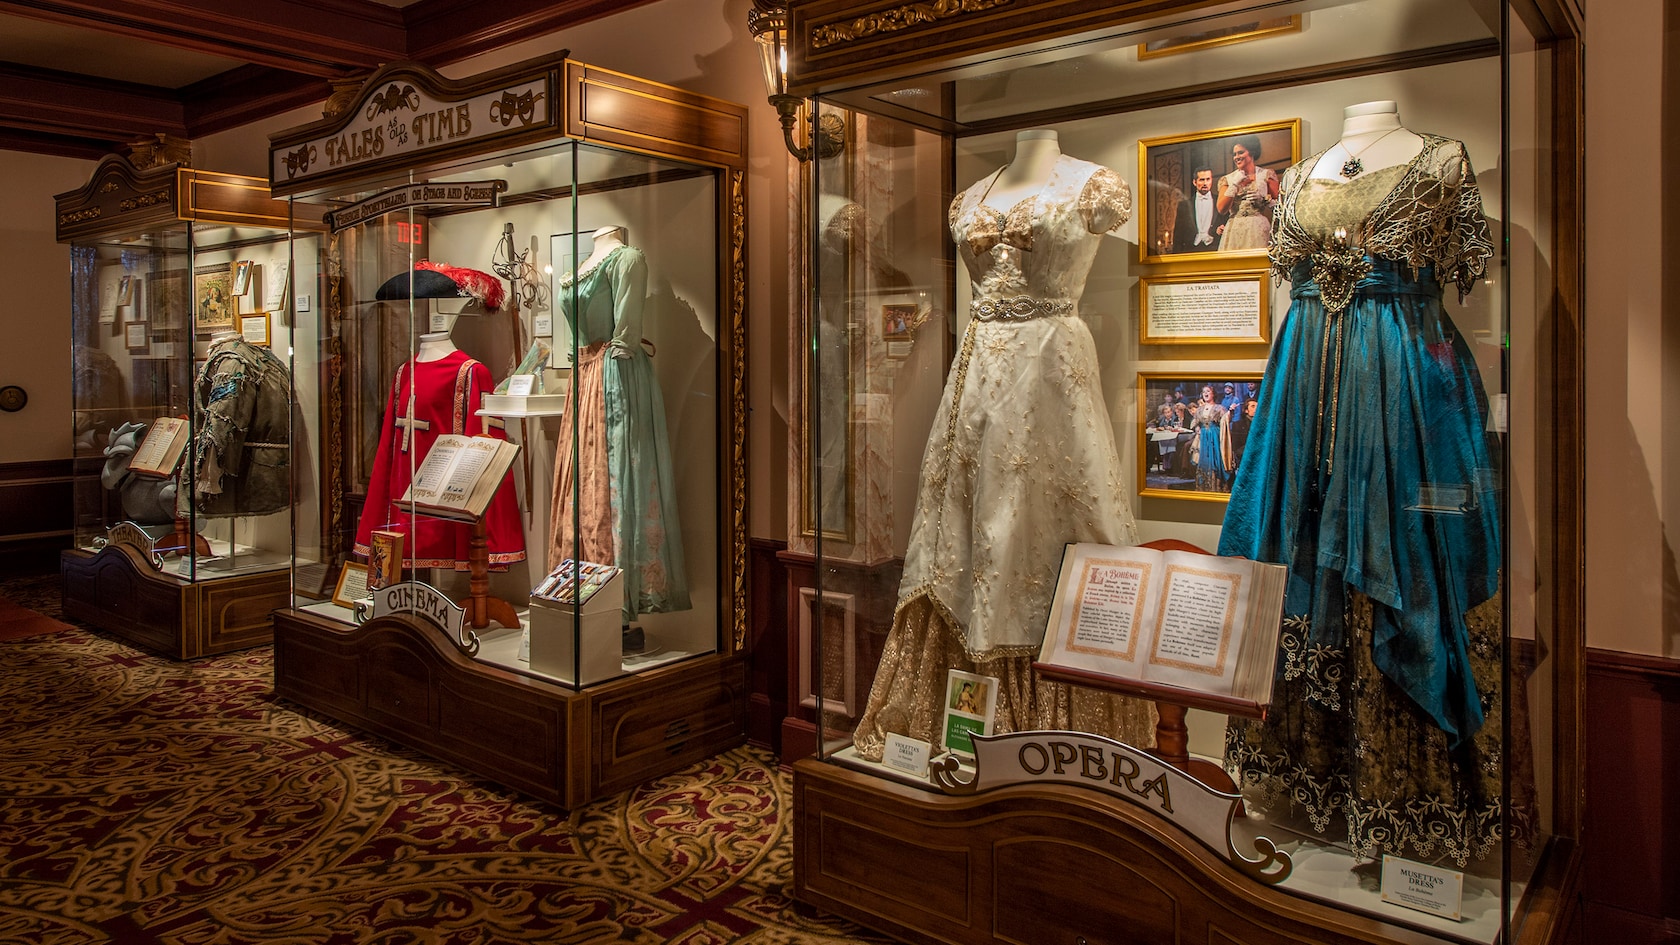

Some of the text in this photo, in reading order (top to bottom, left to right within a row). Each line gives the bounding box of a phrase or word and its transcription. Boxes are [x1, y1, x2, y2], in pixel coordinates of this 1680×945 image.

[325, 103, 472, 166] TALES AS OLD AS TIME
[361, 192, 407, 218] STORYTELLING
[412, 189, 422, 201] ON
[423, 186, 446, 201] STAGE
[447, 188, 462, 199] AND
[387, 588, 449, 629] CINEMA
[1018, 741, 1174, 814] OPERA
[1400, 868, 1444, 885] MUSETTA'S
[1409, 877, 1435, 889] DRESS
